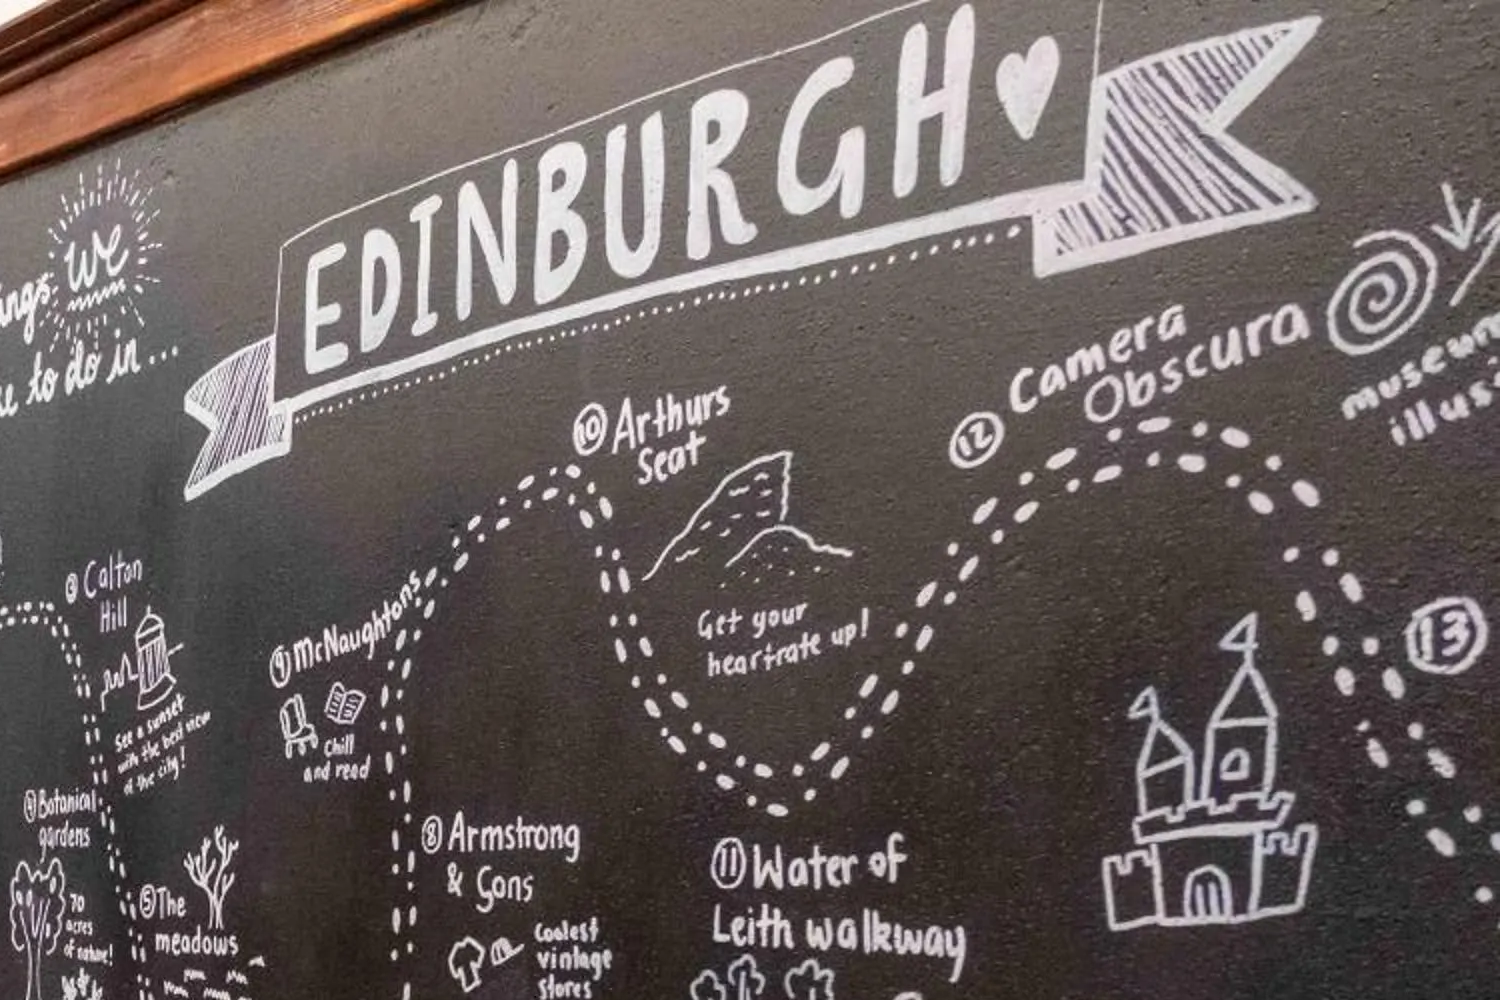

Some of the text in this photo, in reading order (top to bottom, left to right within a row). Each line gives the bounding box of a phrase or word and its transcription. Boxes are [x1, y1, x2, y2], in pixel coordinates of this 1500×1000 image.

[305, 4, 975, 374] EDINBURGH
[26, 352, 58, 404] to
[65, 340, 102, 396] do
[952, 304, 1187, 464] 12 Camera
[1084, 303, 1311, 423] Obscura
[575, 386, 731, 454] 10 Arthurs
[84, 550, 142, 599] Calton
[100, 595, 127, 633] Hill
[293, 569, 421, 673] McNaughtons
[698, 602, 808, 639] Get your
[1410, 602, 1481, 670] 13
[708, 632, 821, 677] heartrate
[335, 754, 371, 780] read
[38, 787, 97, 819] Botanical
[38, 819, 91, 864] gardens
[448, 810, 580, 863] Armstrong
[447, 861, 463, 897] &
[753, 844, 858, 890] Water
[868, 832, 908, 883] of
[70, 893, 85, 913] 70
[156, 886, 187, 920] The
[155, 924, 239, 956] meadows
[712, 903, 794, 949] Leith
[537, 945, 613, 981] vintage
